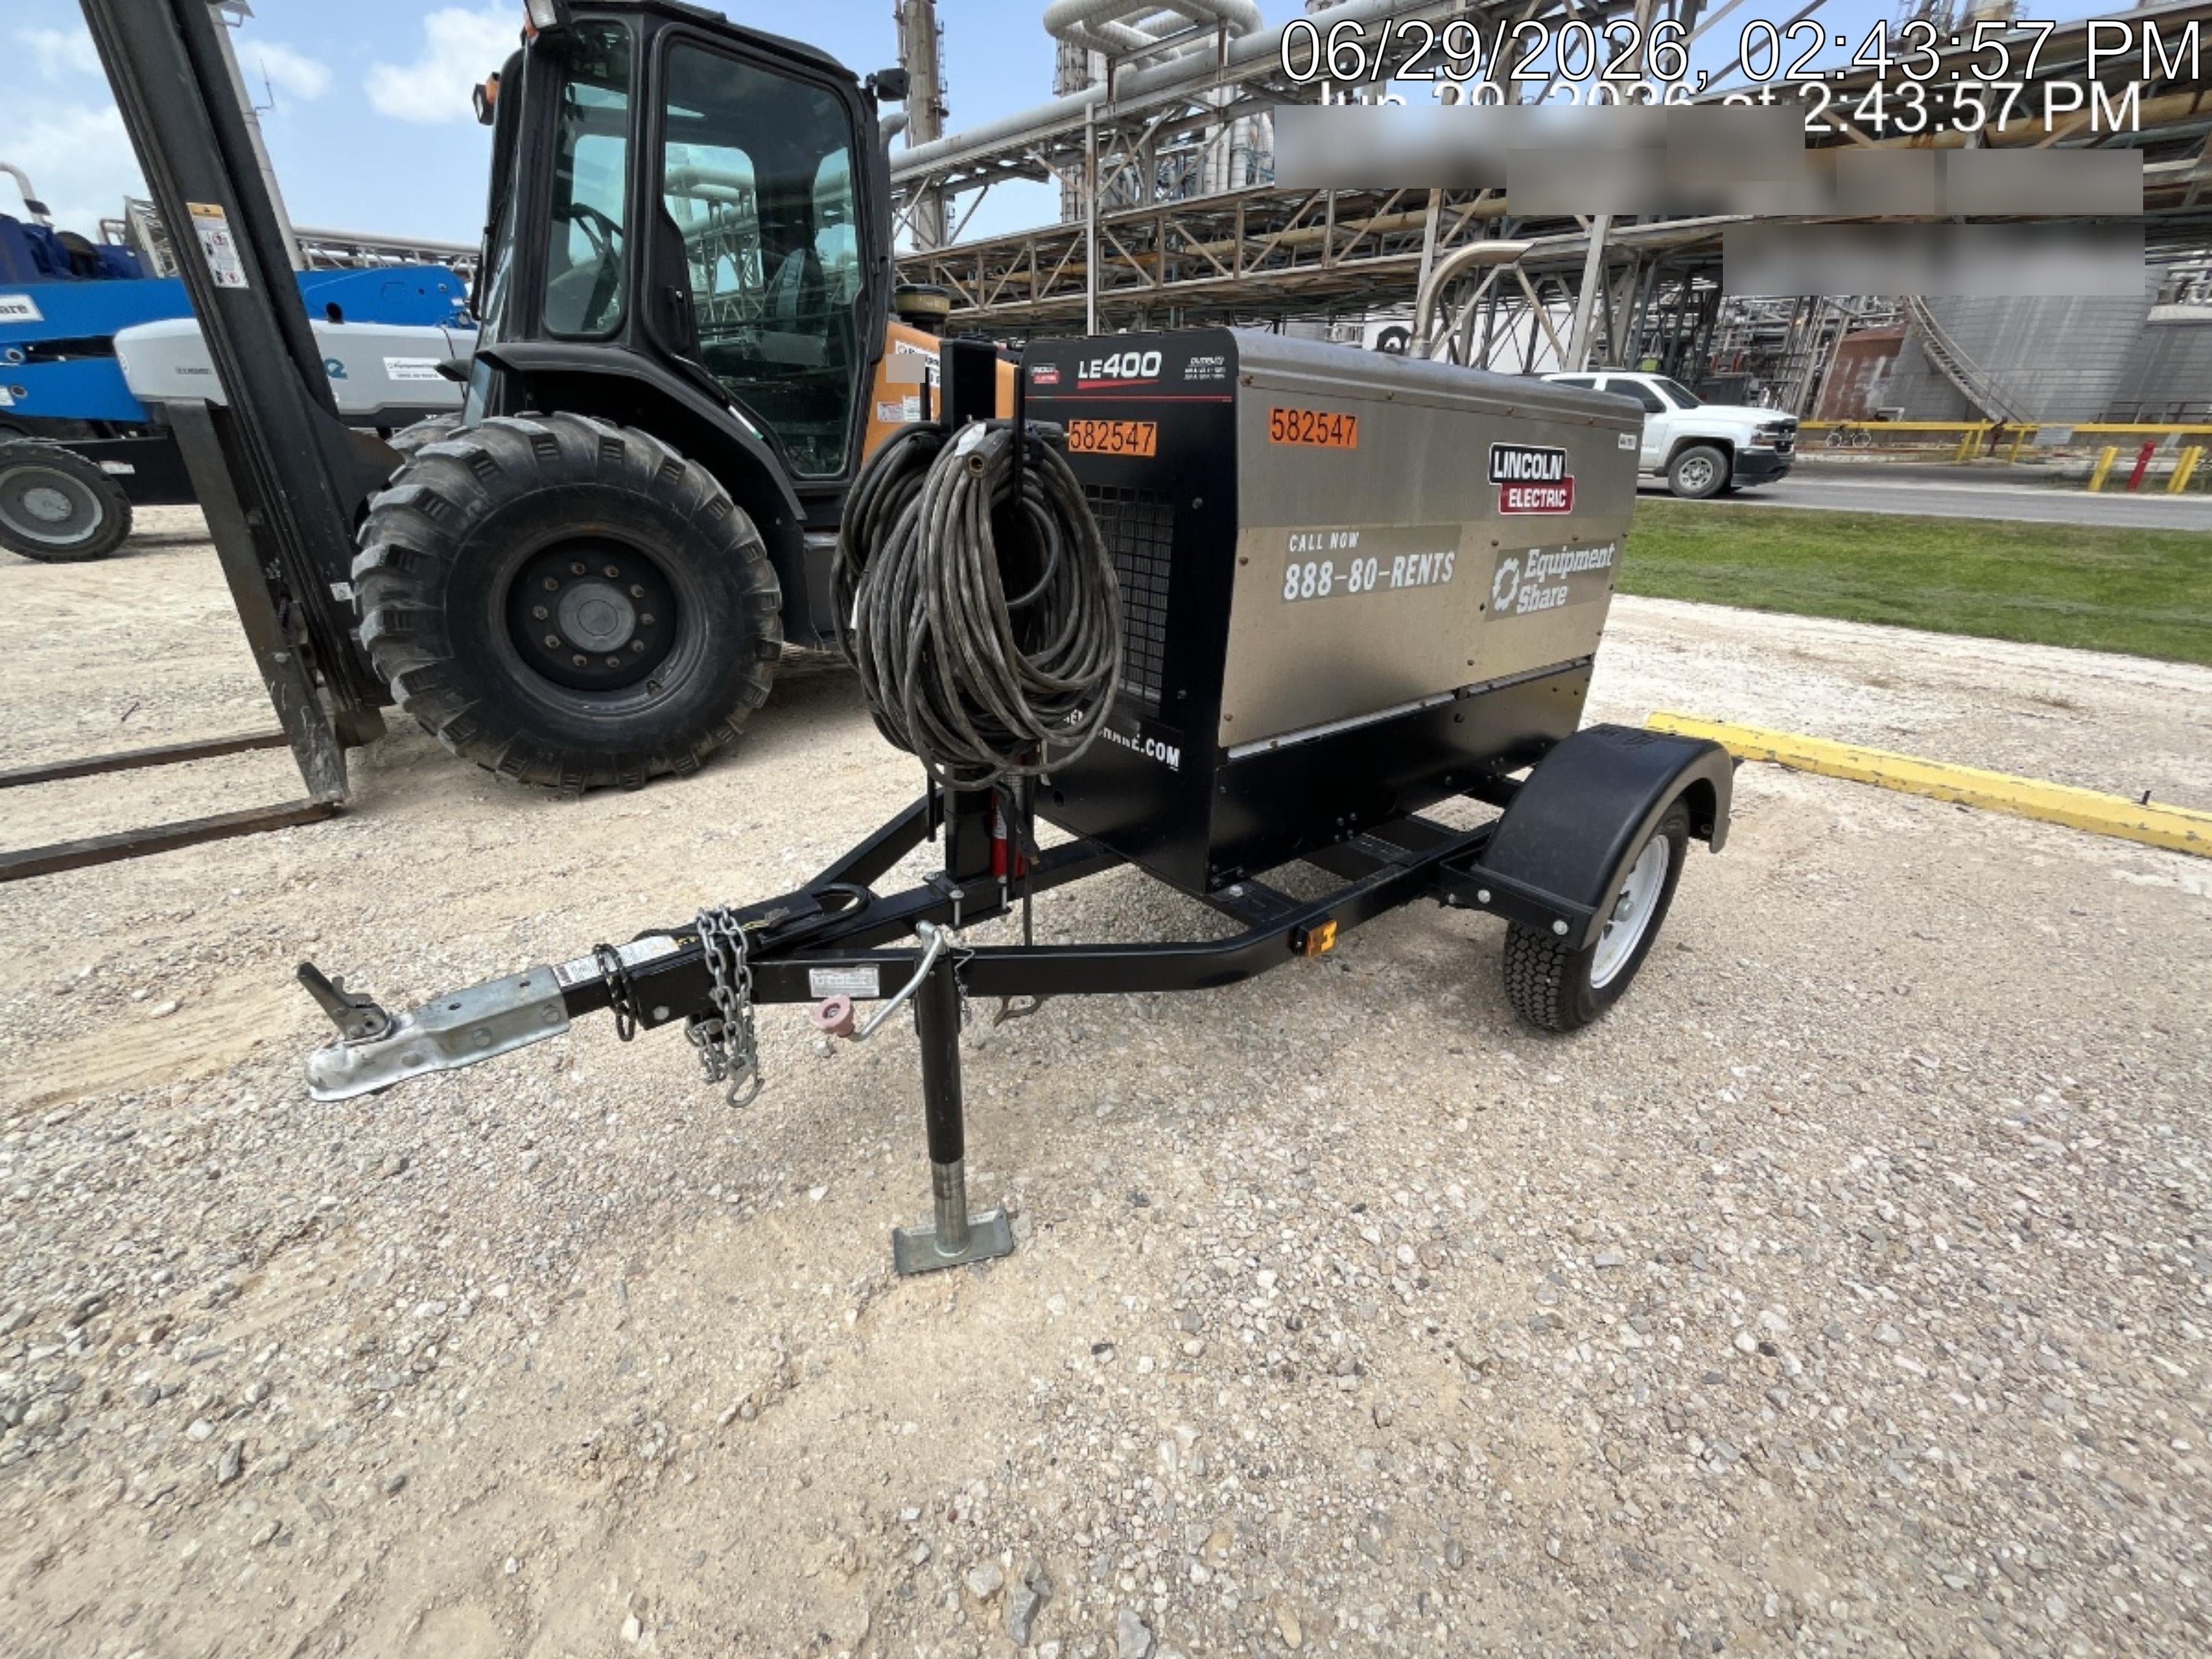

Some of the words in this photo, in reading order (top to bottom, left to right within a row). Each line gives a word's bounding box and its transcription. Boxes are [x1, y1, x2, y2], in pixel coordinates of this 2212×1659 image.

[1078, 351, 1162, 379] LE400
[1070, 421, 1154, 453] 582547
[1271, 408, 1356, 444] 582547
[1494, 450, 1564, 480] LINCOLN
[1508, 488, 1566, 508] ELECTRIC
[1290, 533, 1325, 552] CALL
[1330, 531, 1359, 549] NOW
[1284, 551, 1454, 600] 888-80-RENTS
[1524, 542, 1615, 584] Equipment
[1516, 584, 1568, 614] Share
